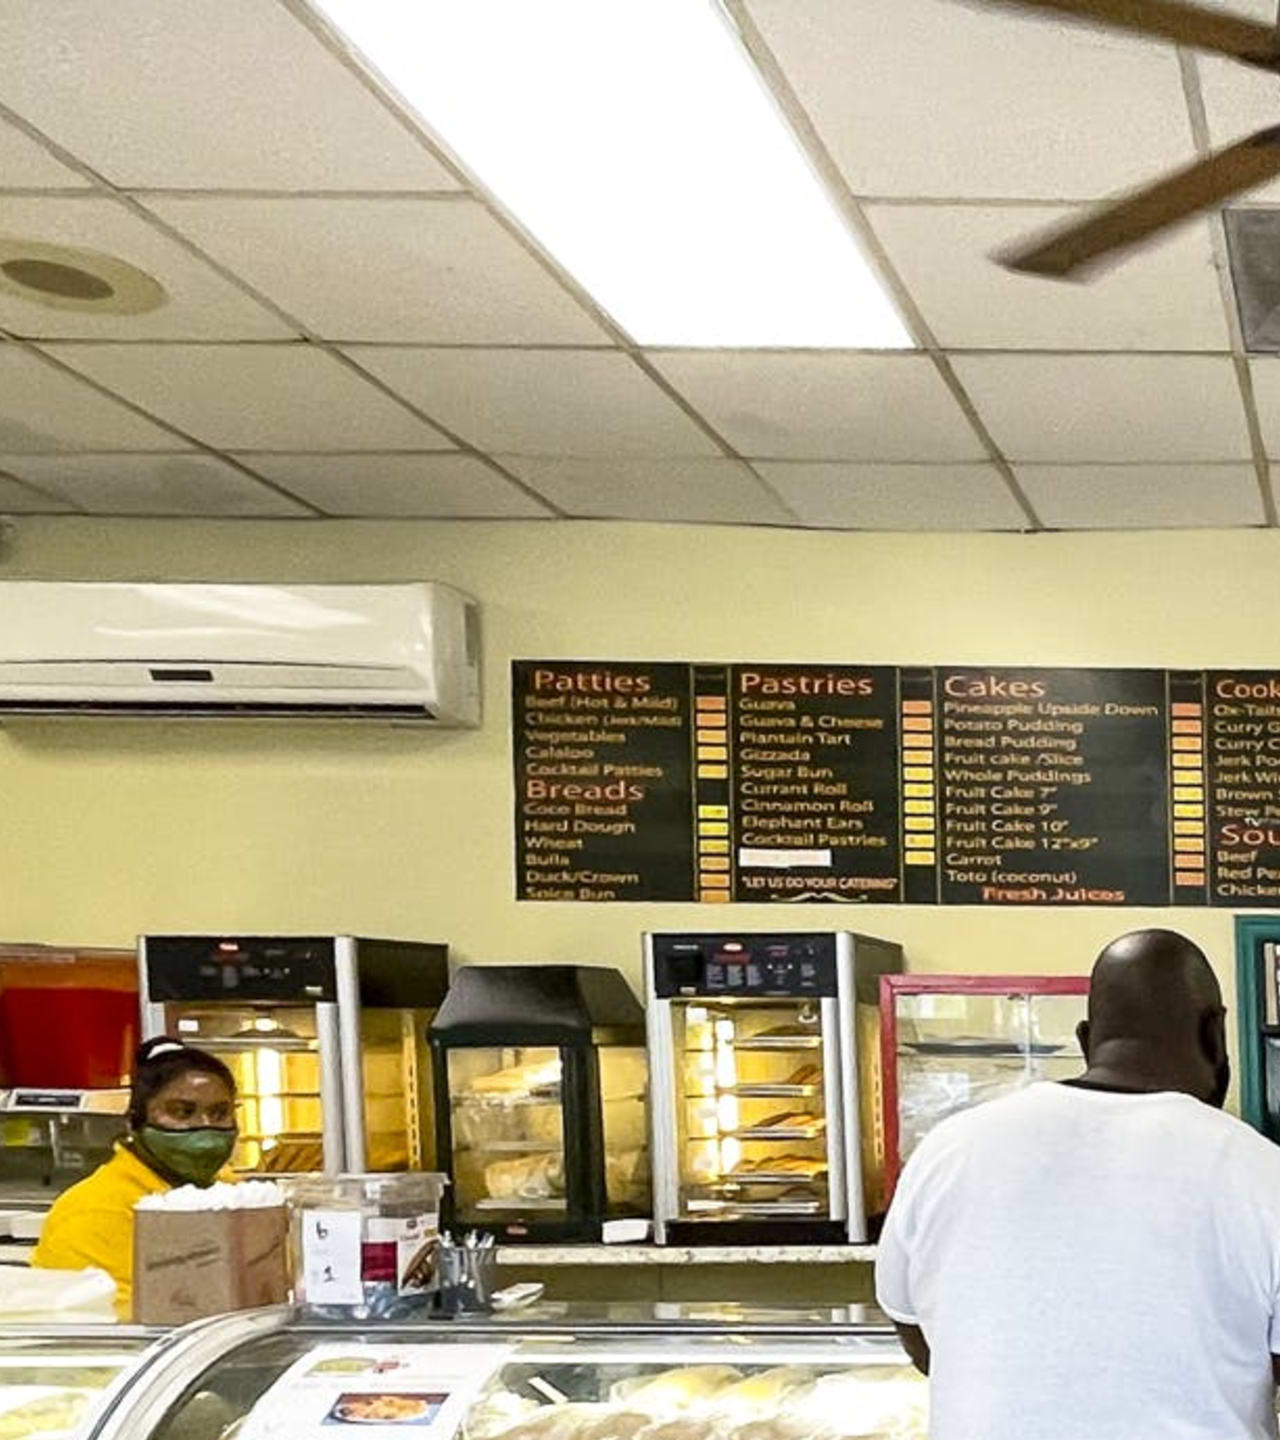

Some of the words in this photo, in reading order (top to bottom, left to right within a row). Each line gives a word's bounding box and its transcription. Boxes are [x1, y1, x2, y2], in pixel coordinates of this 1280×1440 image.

[535, 670, 651, 692] Patties
[740, 673, 873, 694] Pastries
[944, 676, 1046, 697] Cakes
[1104, 703, 1158, 716] Down
[945, 719, 1002, 732] Potato
[1008, 720, 1083, 734] Pudding
[1214, 722, 1263, 735] Curry
[815, 734, 851, 745] Tart
[945, 736, 996, 748] Bread
[1001, 737, 1076, 750] Pudding
[1215, 739, 1264, 751] Curry
[741, 766, 792, 780] Sugar
[798, 767, 833, 778] Bun
[945, 770, 1002, 782] Whole
[1008, 770, 1091, 785] Puddings
[526, 780, 644, 800] Breads
[813, 784, 847, 795] Roll
[991, 787, 1034, 799] Cake
[1216, 789, 1272, 800] Brown
[741, 800, 834, 812] Cinnamon
[839, 800, 873, 812] Roll
[991, 804, 1034, 815] Cake
[1216, 806, 1260, 817] Stew
[524, 820, 568, 832] Hard
[574, 821, 635, 834] Dough
[827, 818, 863, 829] Ears
[991, 820, 1034, 832] Cake
[525, 836, 583, 849] Wheat
[991, 837, 1034, 849] Cake
[946, 854, 1002, 866] Carrot
[1217, 868, 1252, 879] Red
[982, 887, 1046, 900] Fresh
[1050, 888, 1125, 902] Juices
